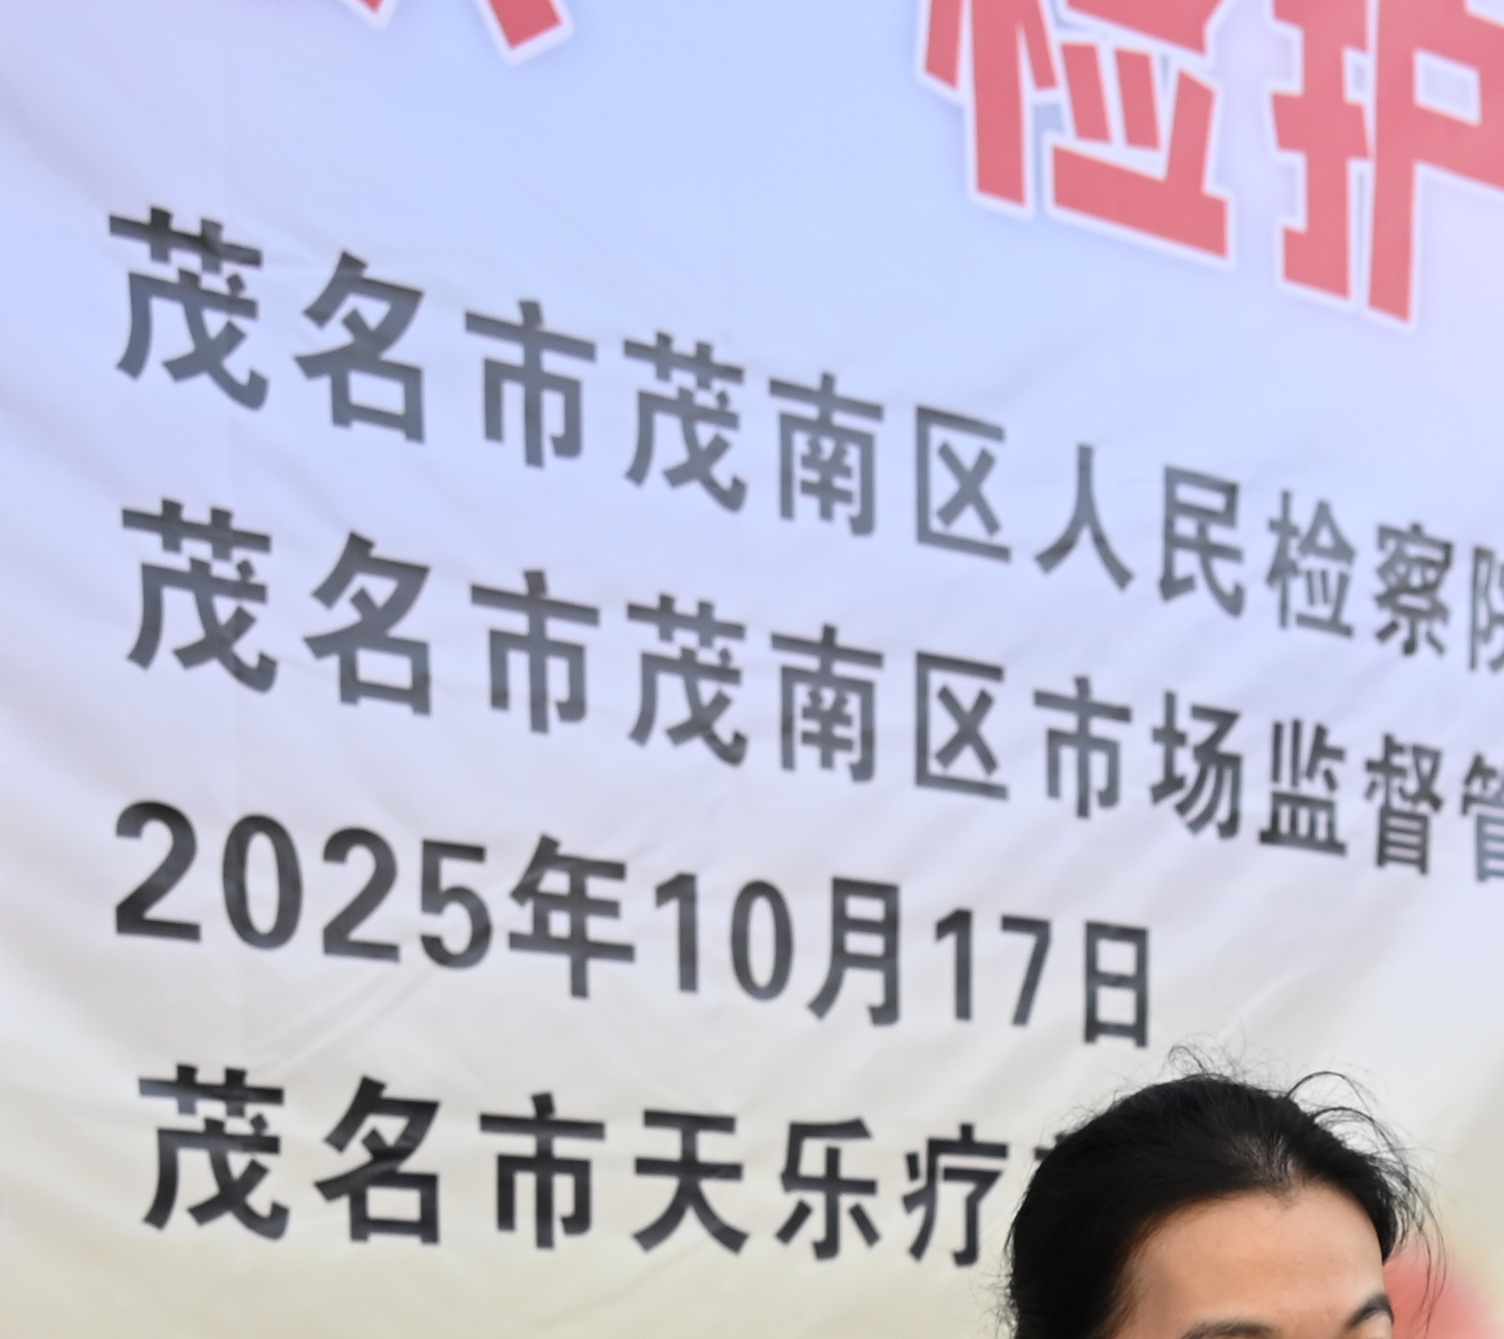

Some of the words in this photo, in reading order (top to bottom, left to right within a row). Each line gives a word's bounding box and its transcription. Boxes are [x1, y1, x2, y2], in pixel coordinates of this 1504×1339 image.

[112, 798, 1154, 1048] 2025年10月17日
[138, 1064, 1076, 1268] 茂名市天乐疗
